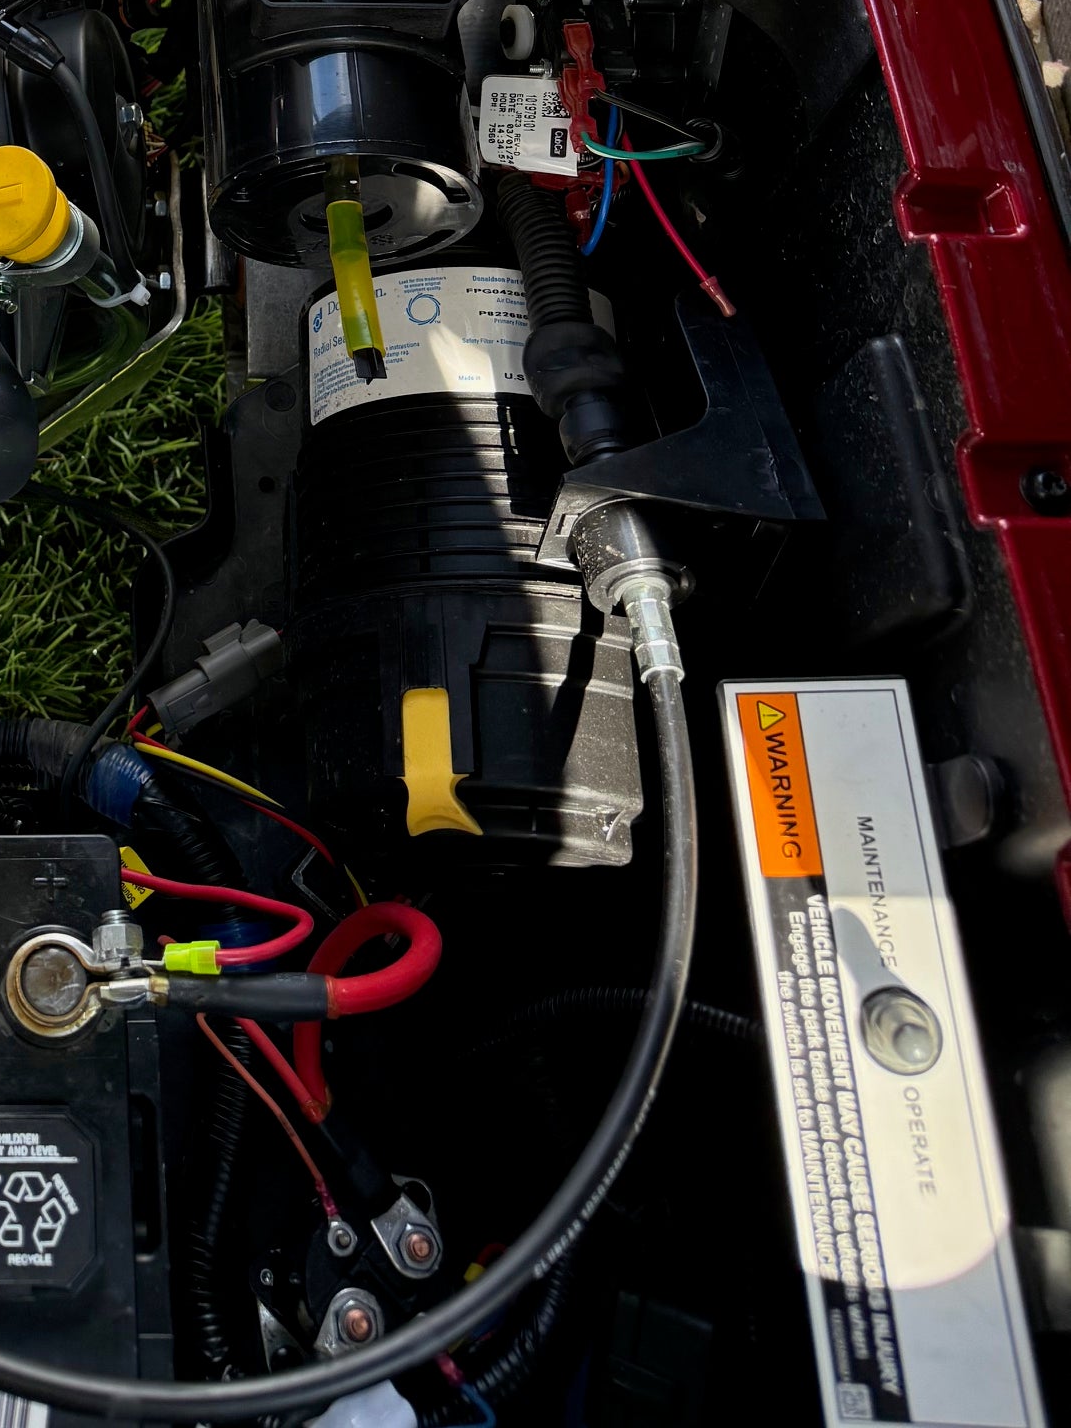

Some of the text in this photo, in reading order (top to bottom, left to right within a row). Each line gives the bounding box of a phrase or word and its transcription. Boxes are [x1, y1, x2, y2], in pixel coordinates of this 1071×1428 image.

[488, 122, 497, 144] 7560
[498, 92, 507, 117] HOUR:
[505, 92, 517, 164] DATE: 03/01/24
[523, 94, 538, 132] 101979101
[513, 133, 521, 156] REV-D
[507, 277, 519, 285] Part
[762, 730, 802, 858] WARNING
[856, 816, 897, 971] MAINTENANCE
[806, 894, 835, 975] VEHICLE
[818, 976, 854, 1090] MOVEMENT
[835, 1090, 861, 1137] MAY
[902, 1086, 937, 1194] OPERATE
[843, 1137, 872, 1211] CAUSE
